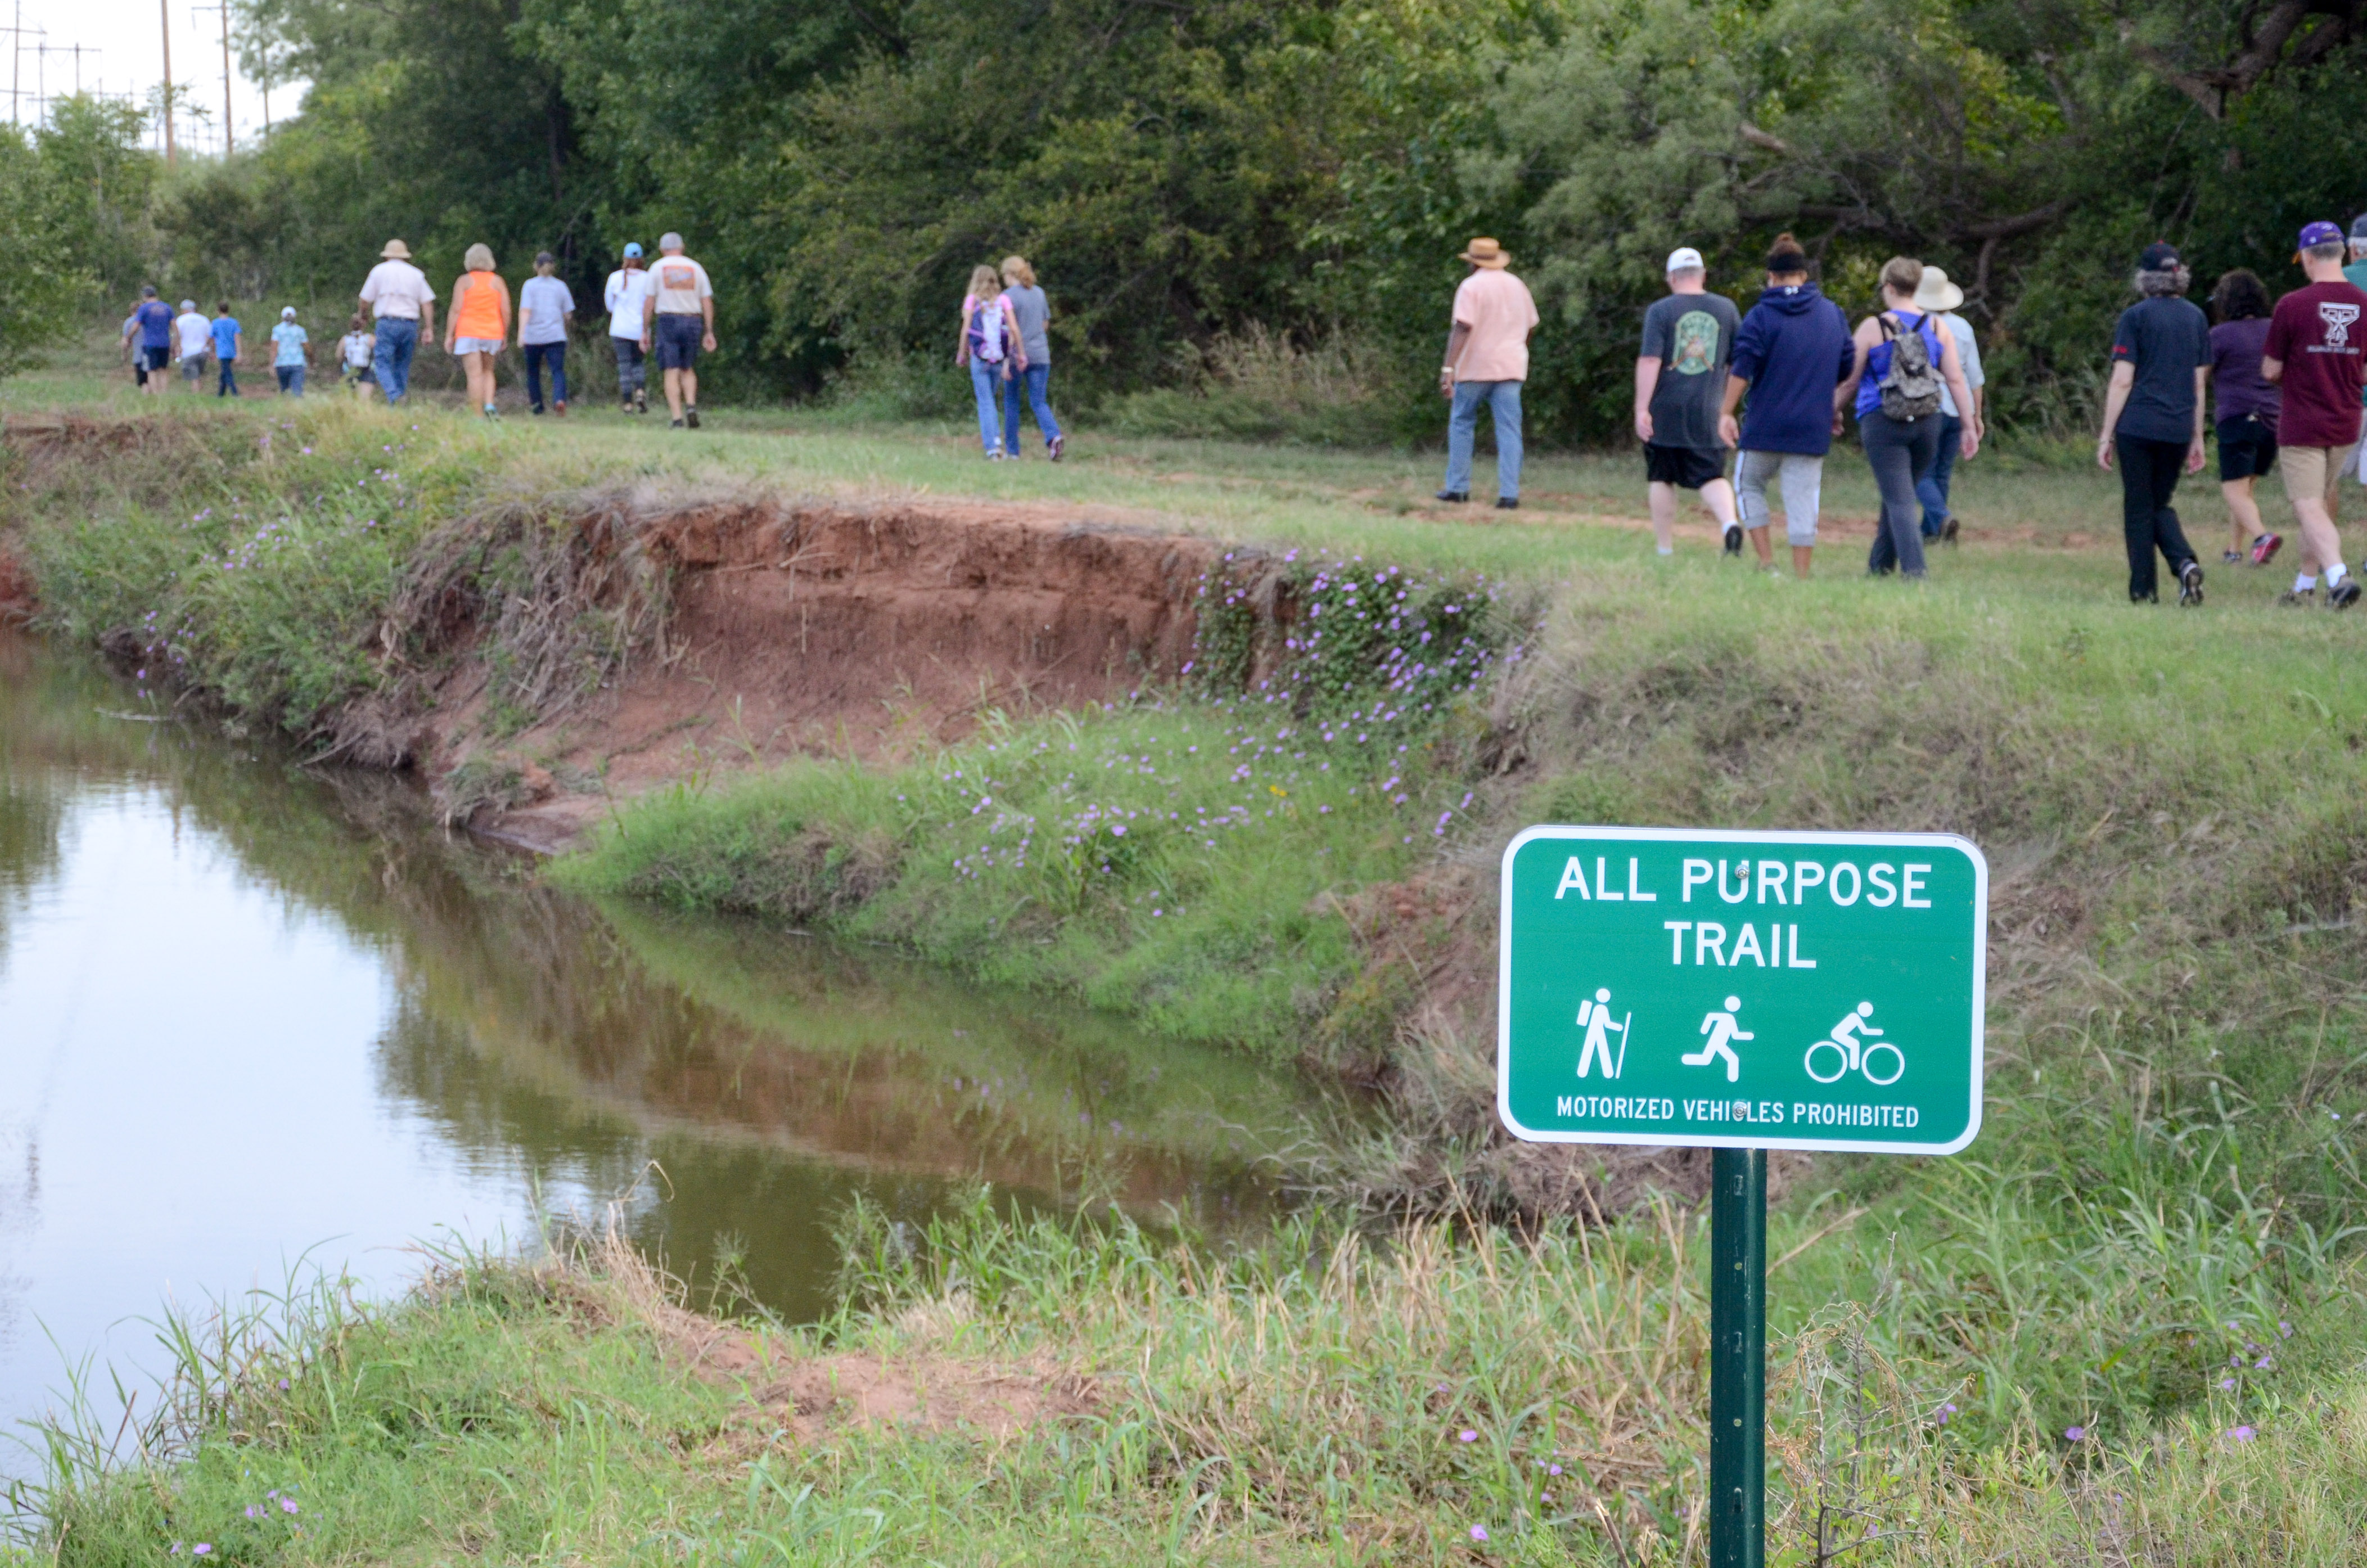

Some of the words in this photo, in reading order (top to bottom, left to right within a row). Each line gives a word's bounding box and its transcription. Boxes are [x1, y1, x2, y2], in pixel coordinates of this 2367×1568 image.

[1555, 857, 1656, 901] ALL
[1683, 859, 1931, 908] PURPOSE
[1664, 921, 1816, 968] TRAIL
[1557, 1096, 1674, 1119] MOTORIZED
[1793, 1102, 1919, 1128] PROHIBITED
